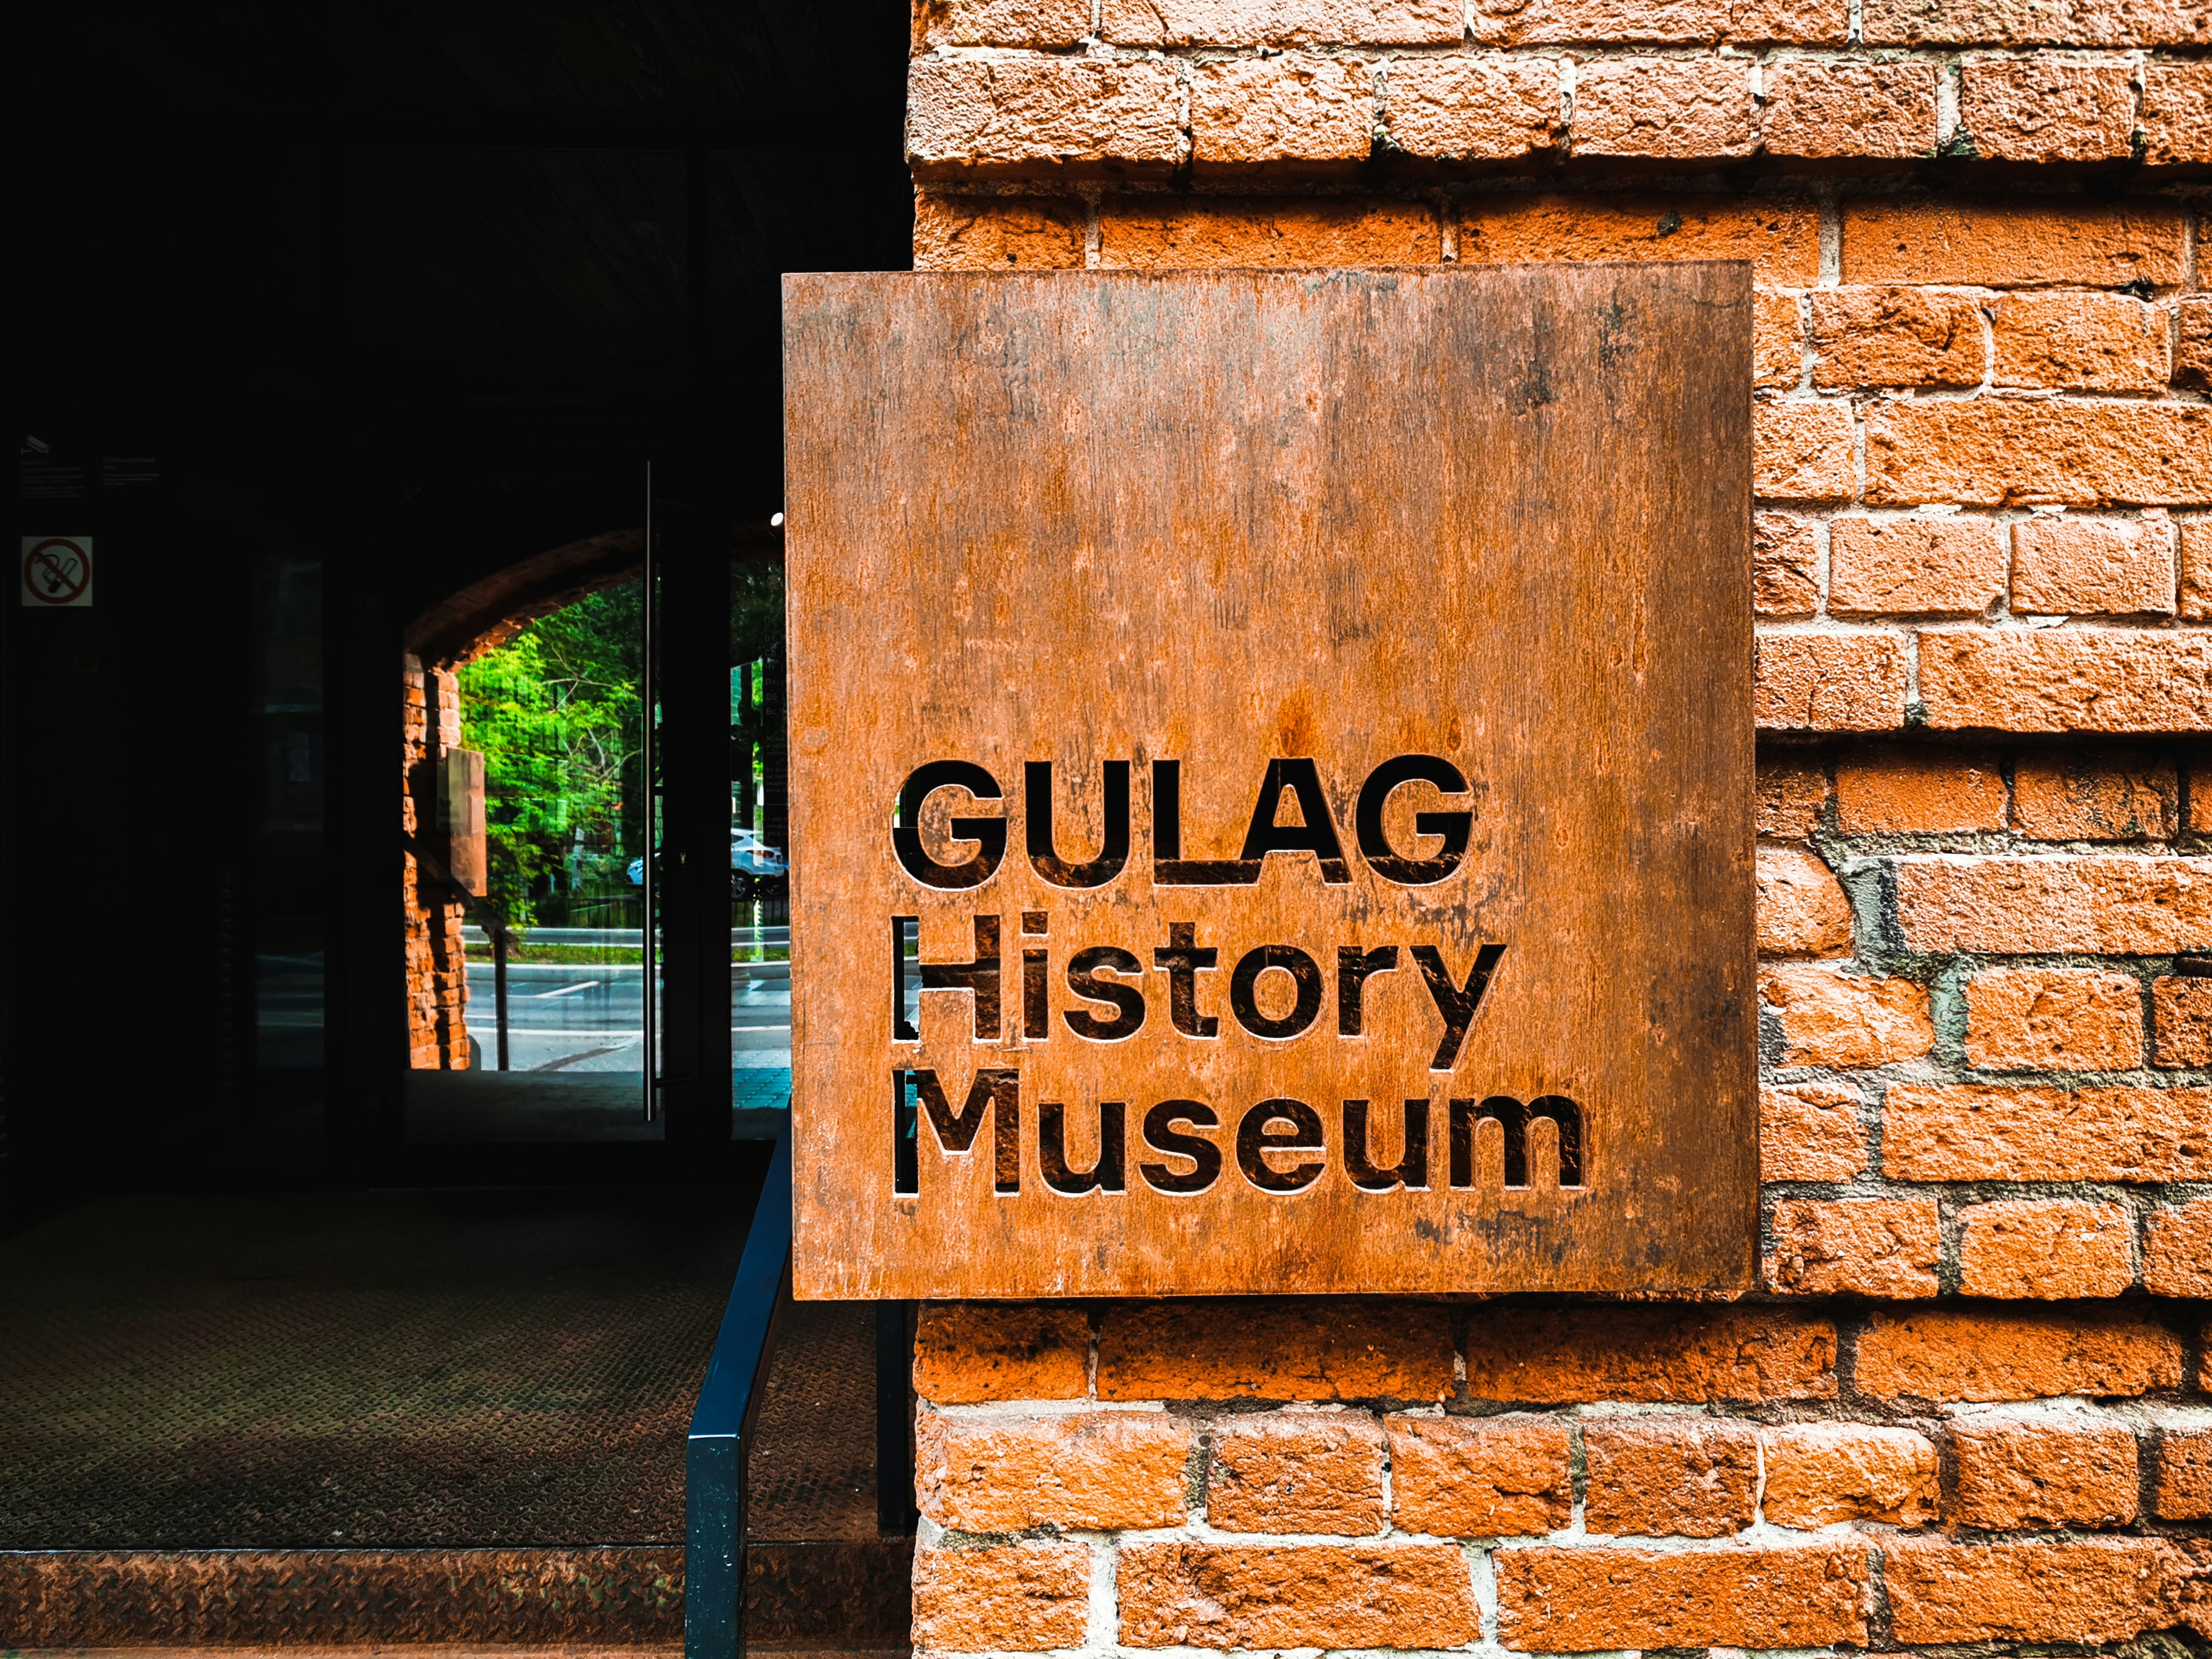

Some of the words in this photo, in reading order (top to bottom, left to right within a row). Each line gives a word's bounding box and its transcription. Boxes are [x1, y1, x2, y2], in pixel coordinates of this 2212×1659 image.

[892, 754, 1473, 891] GULAG
[891, 911, 1508, 1073] History
[892, 1068, 1587, 1199] Museum
